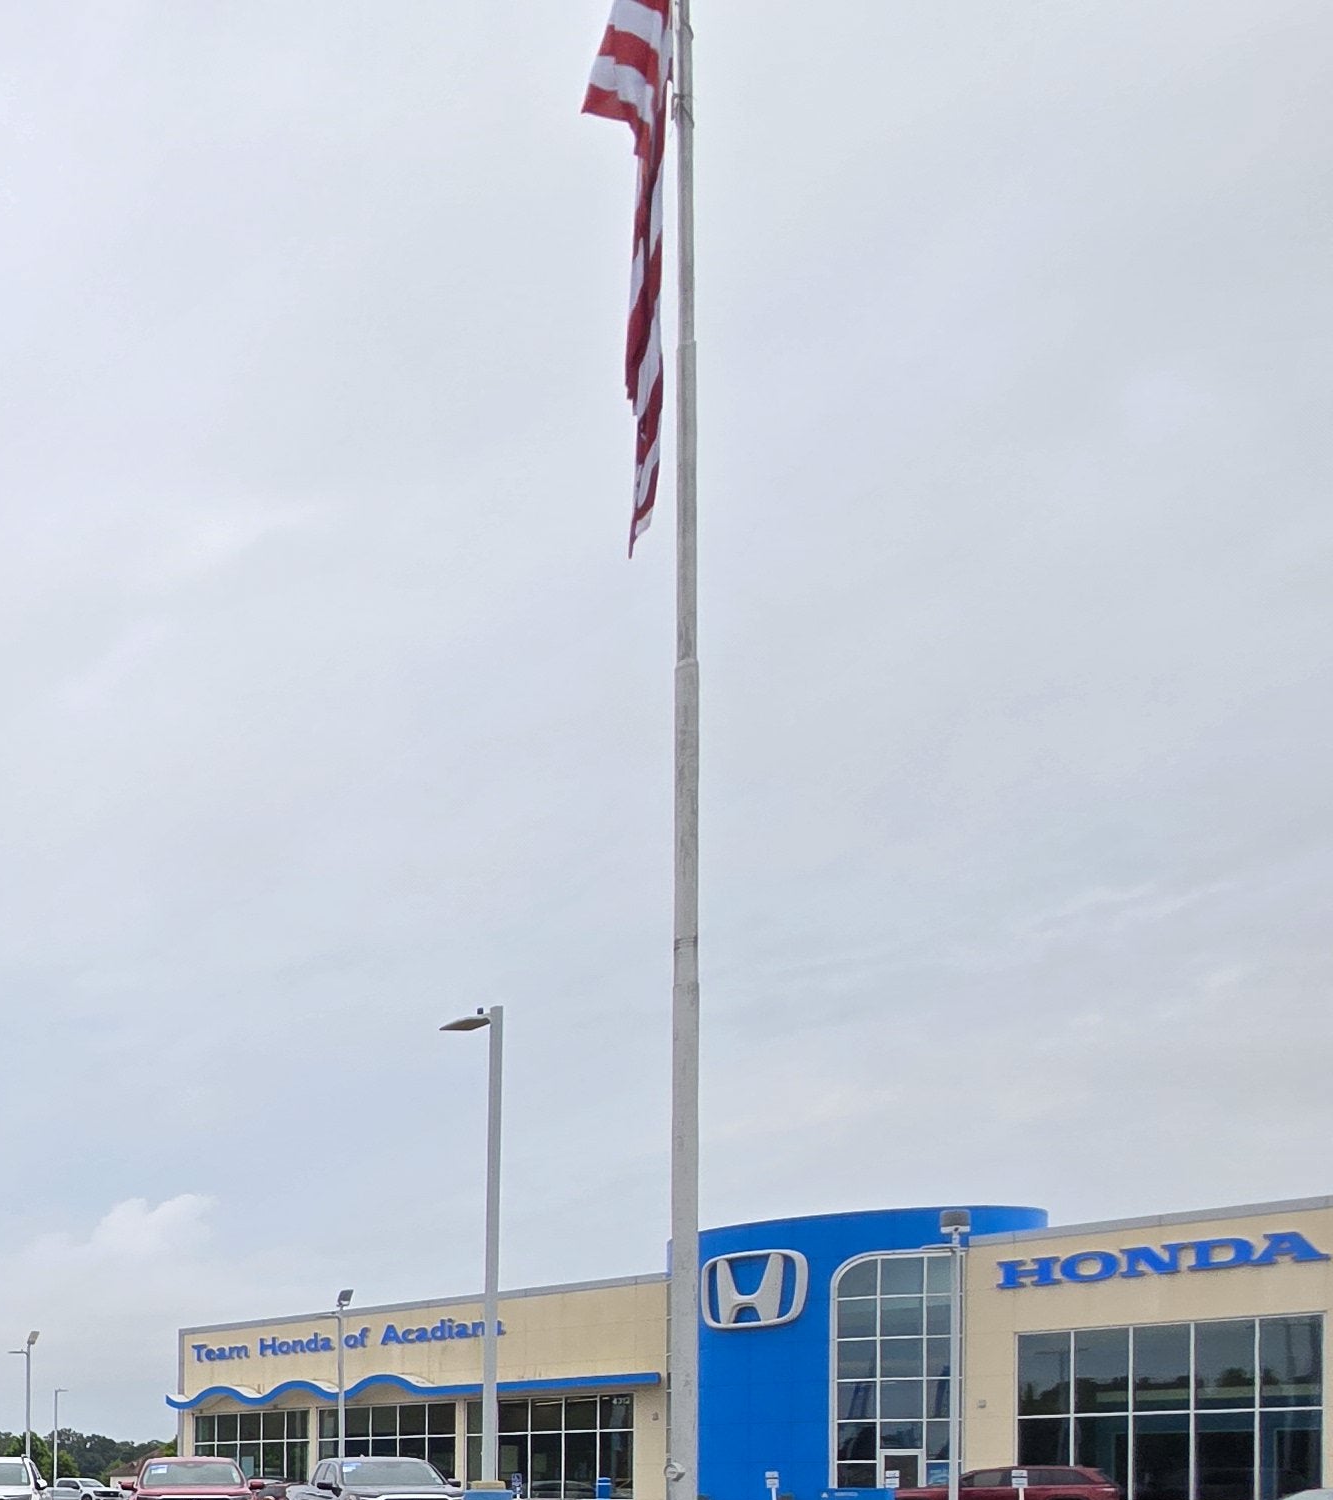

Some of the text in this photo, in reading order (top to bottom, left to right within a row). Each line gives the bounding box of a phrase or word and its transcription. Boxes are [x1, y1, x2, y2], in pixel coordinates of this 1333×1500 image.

[995, 1231, 1331, 1290] HONDA
[191, 1343, 250, 1363] Team
[259, 1332, 335, 1358] Honda
[344, 1327, 372, 1349] of
